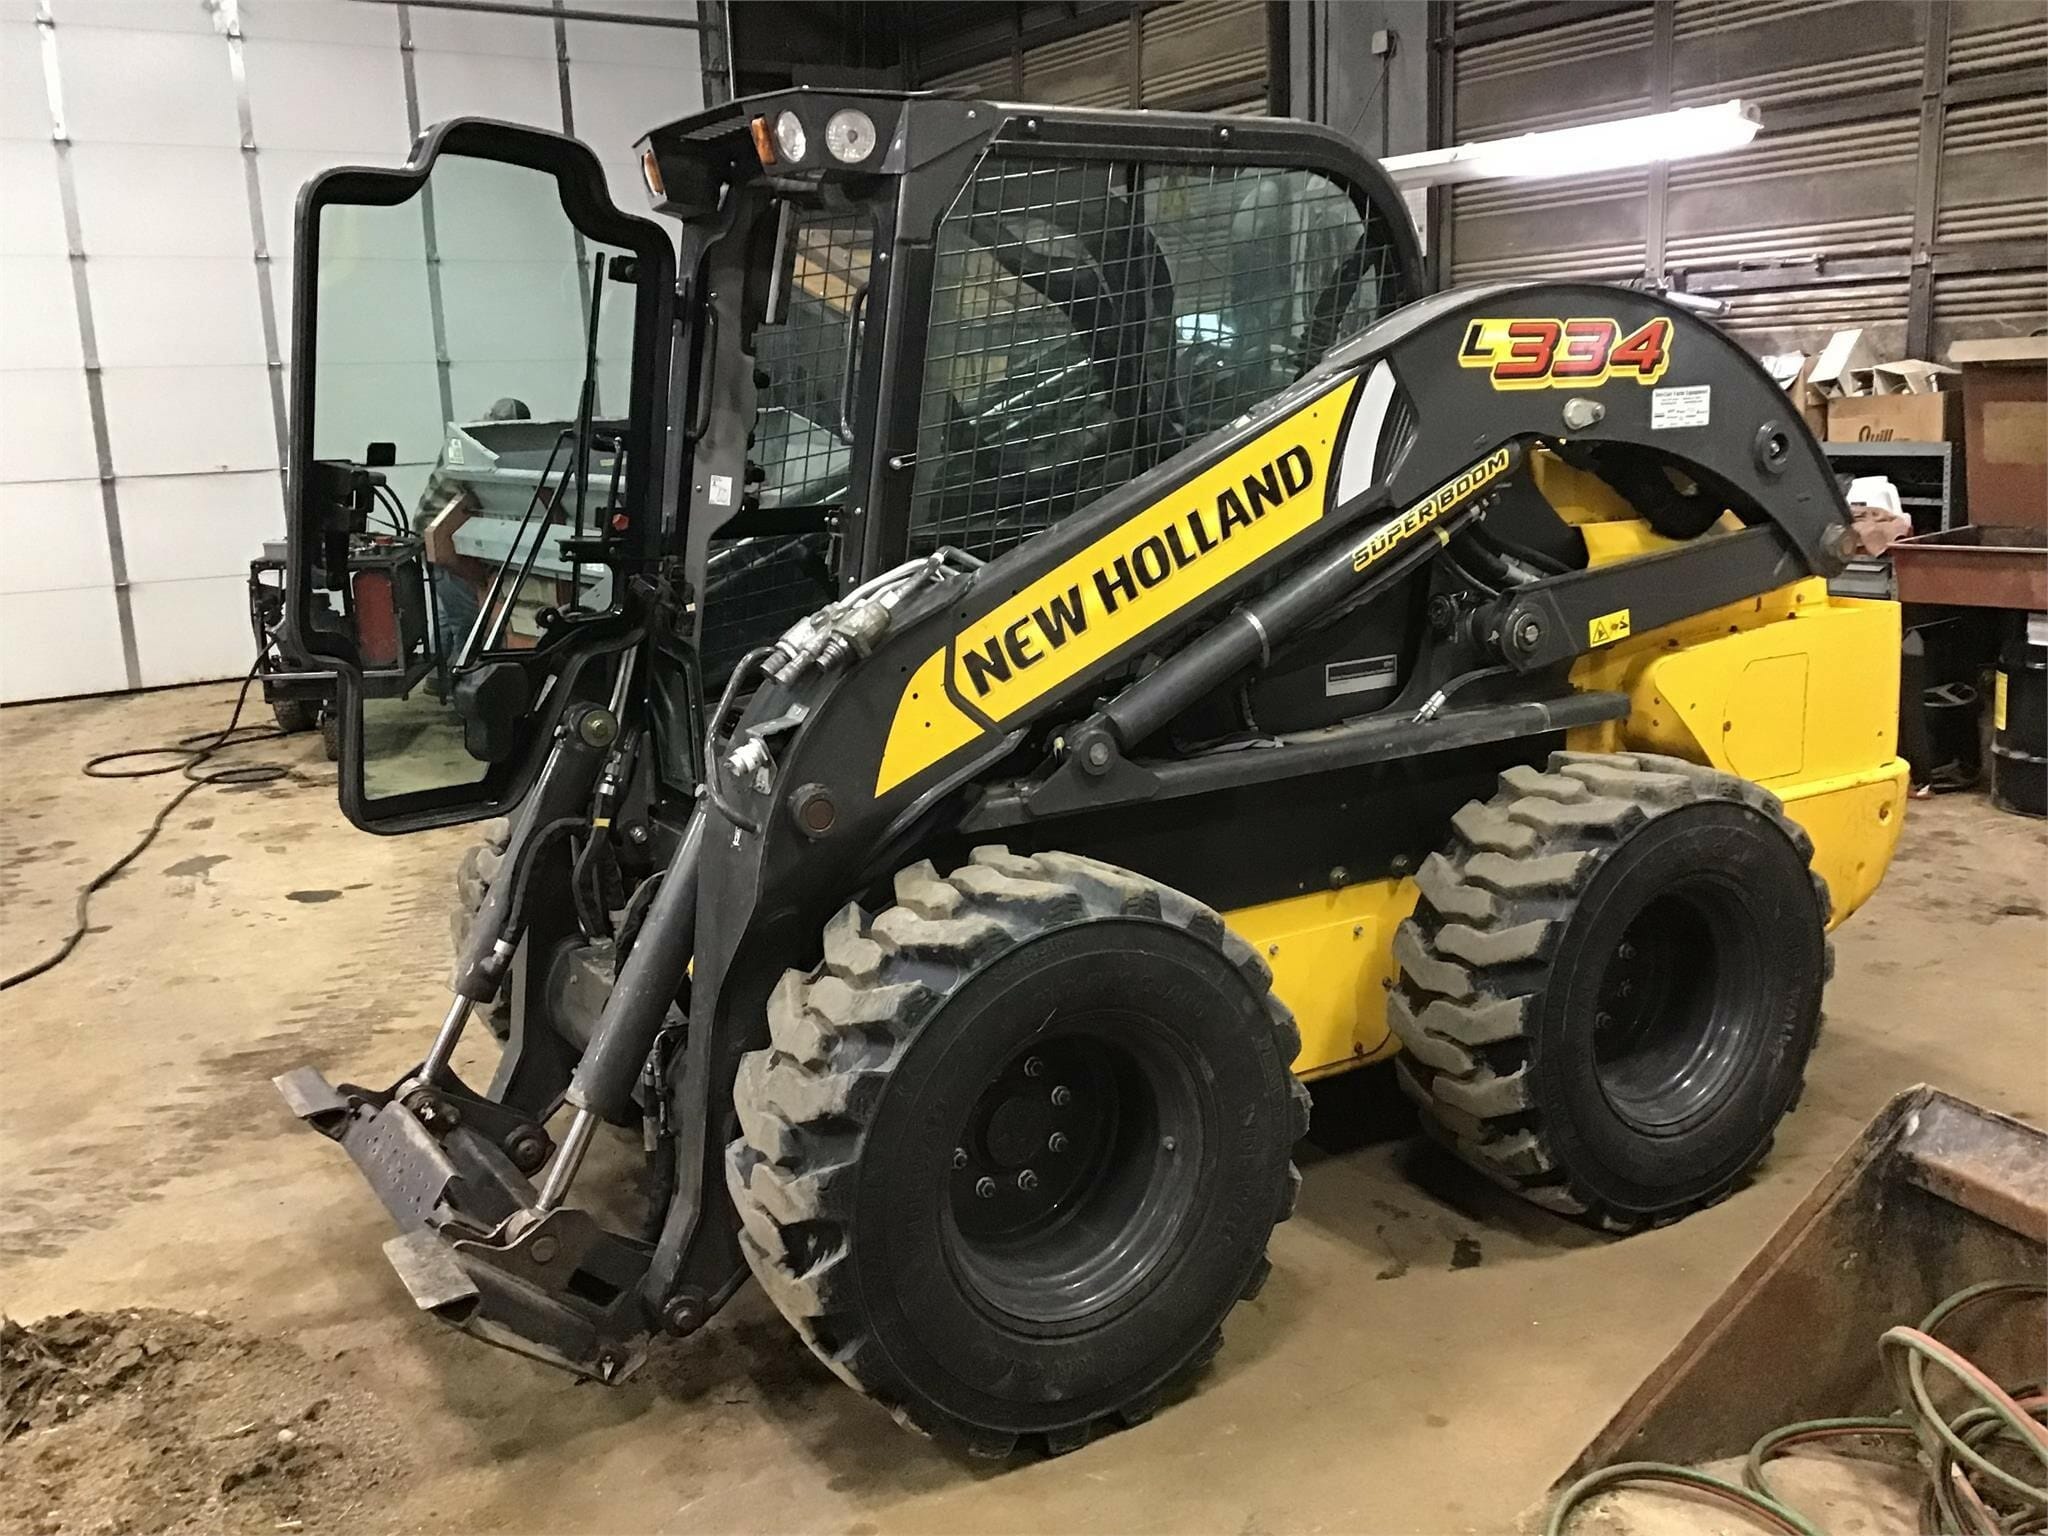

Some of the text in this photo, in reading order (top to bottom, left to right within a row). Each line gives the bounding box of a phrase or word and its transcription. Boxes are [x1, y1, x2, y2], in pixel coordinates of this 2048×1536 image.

[1460, 319, 1671, 388] L334
[962, 445, 1314, 698] NEW HOLLAND
